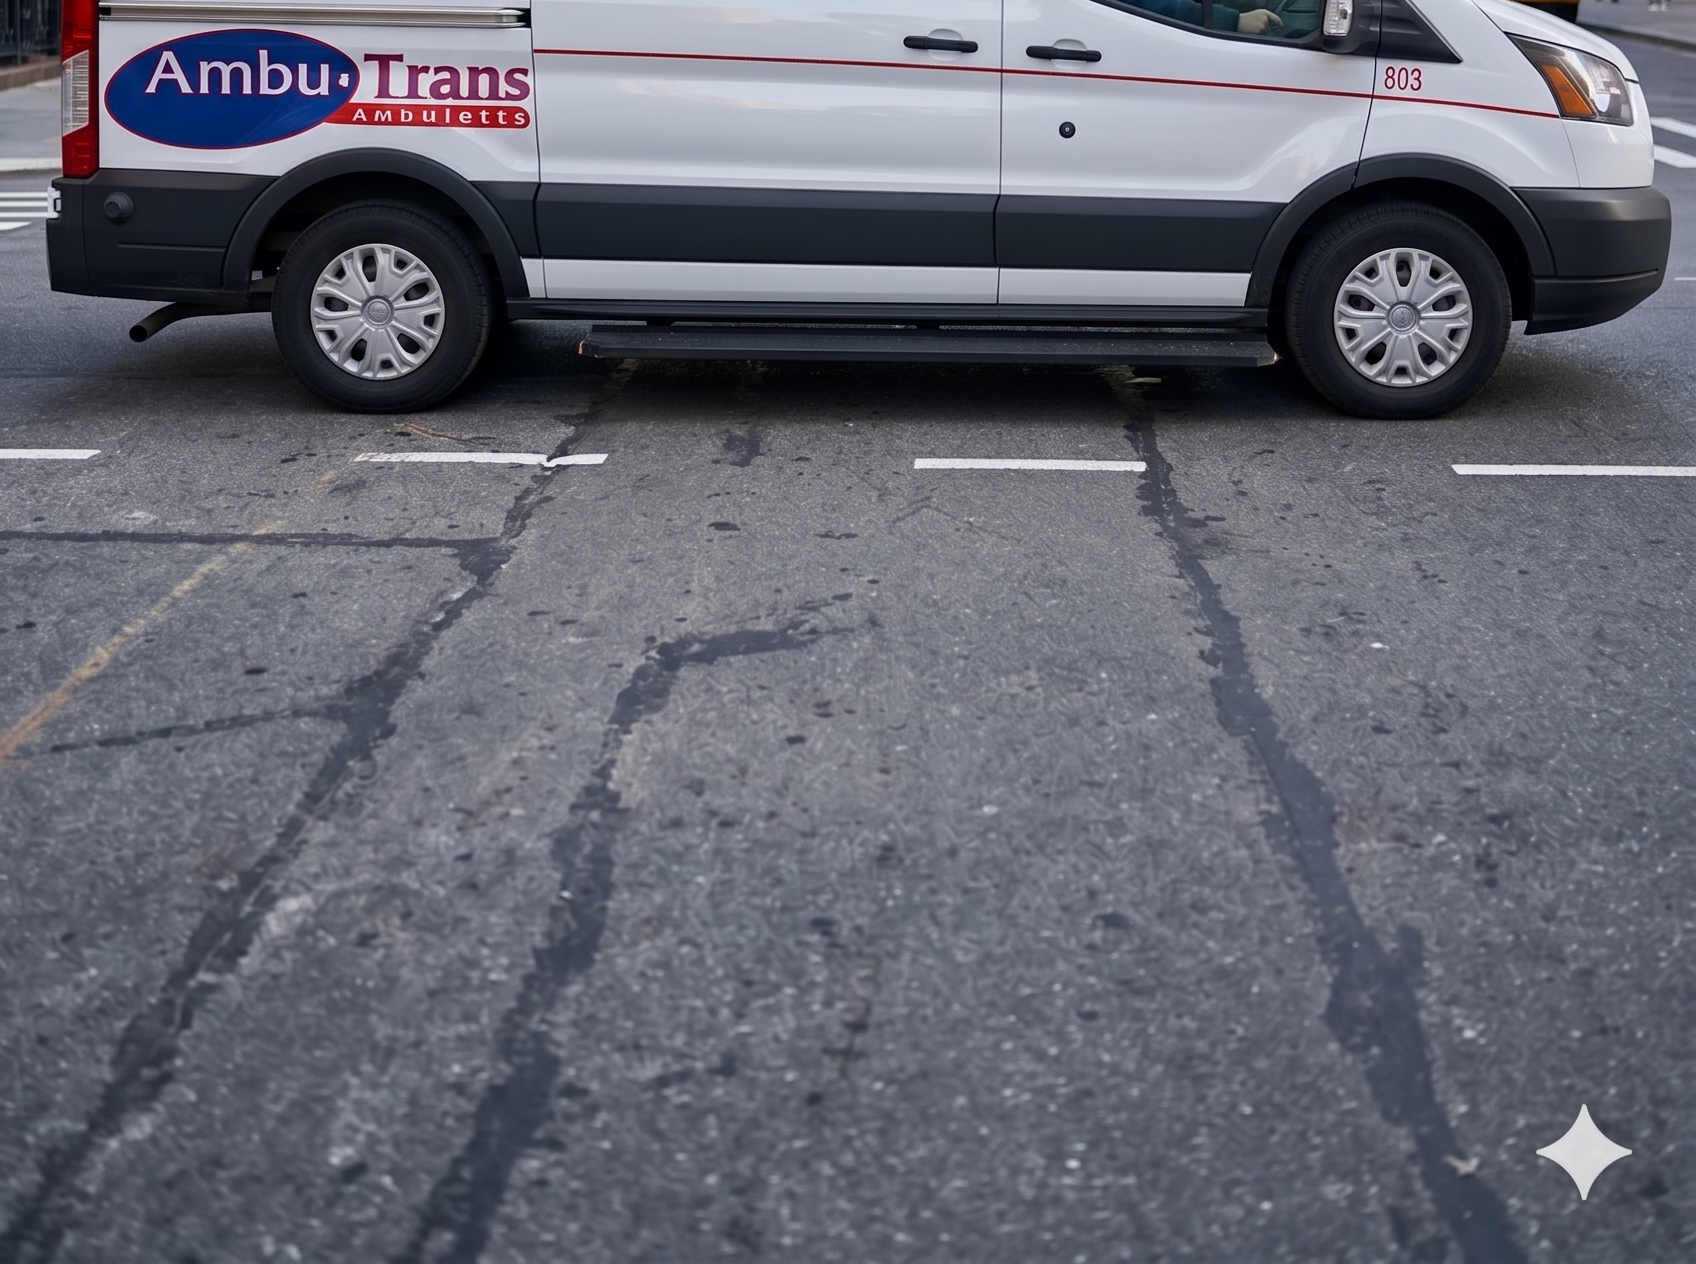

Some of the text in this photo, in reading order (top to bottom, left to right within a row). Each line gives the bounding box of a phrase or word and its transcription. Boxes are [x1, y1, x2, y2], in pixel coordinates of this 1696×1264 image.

[145, 49, 530, 102] Ambu Trans
[1384, 66, 1422, 91] 803
